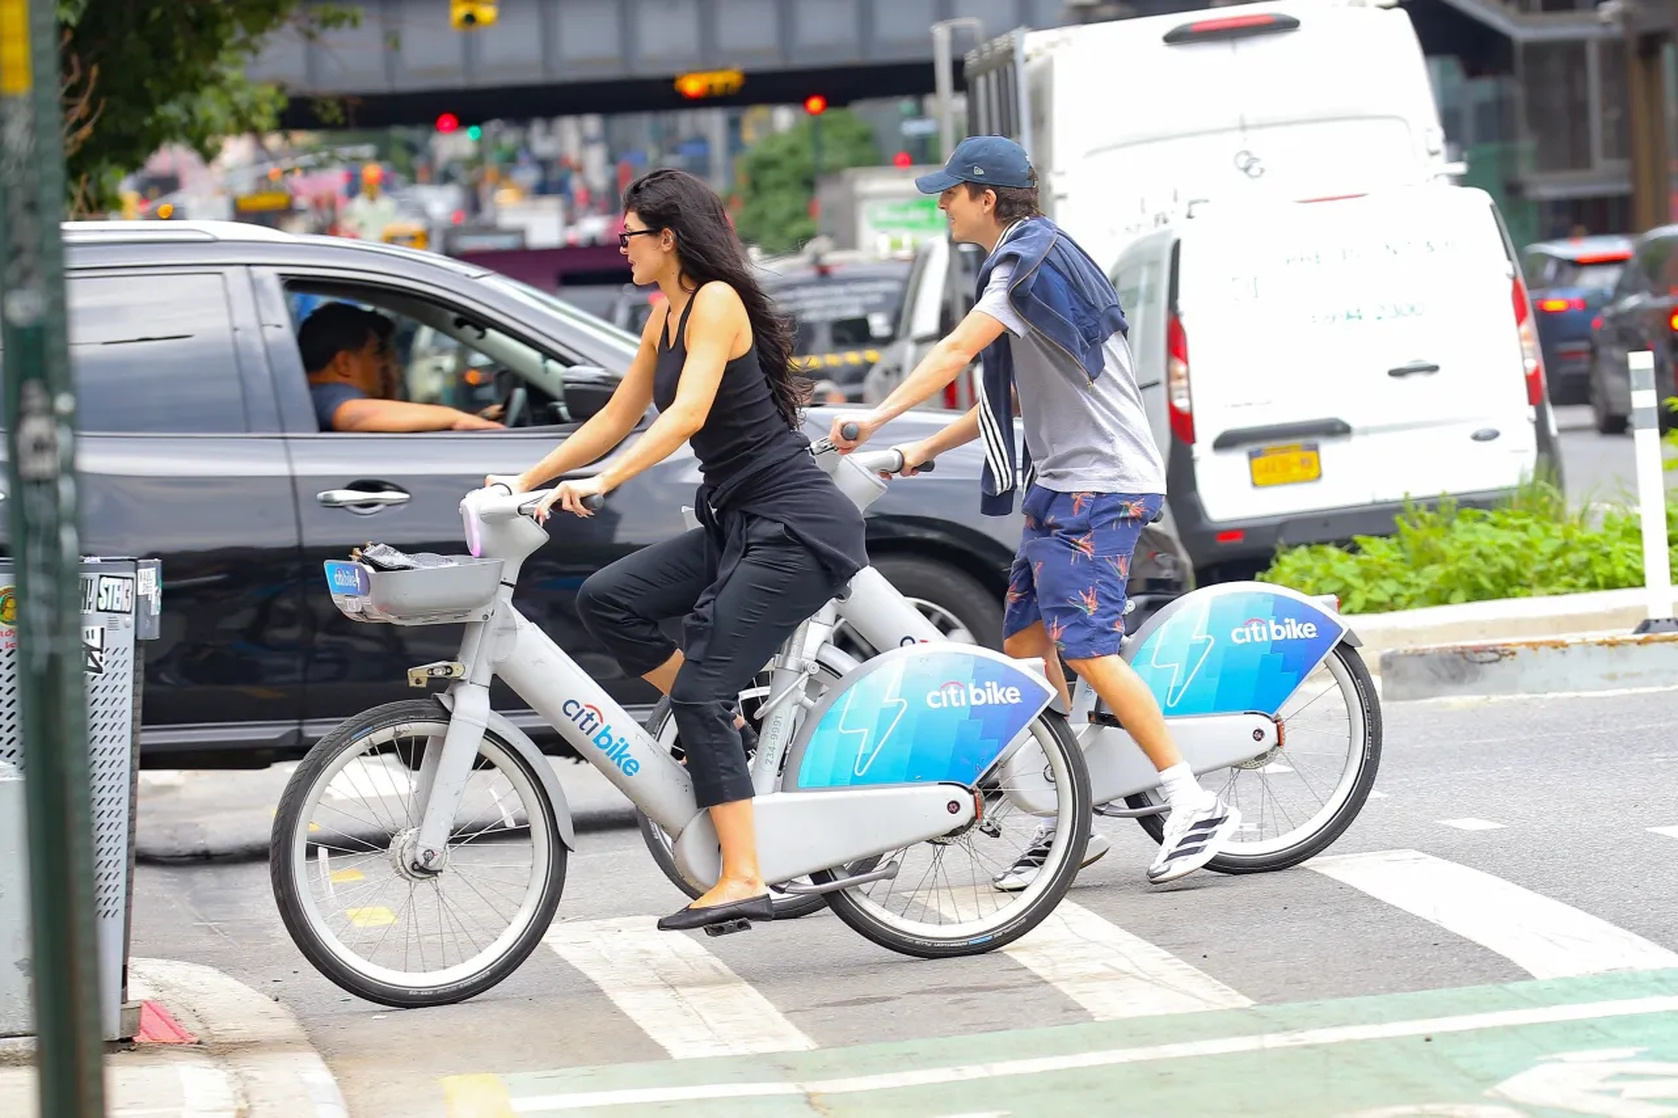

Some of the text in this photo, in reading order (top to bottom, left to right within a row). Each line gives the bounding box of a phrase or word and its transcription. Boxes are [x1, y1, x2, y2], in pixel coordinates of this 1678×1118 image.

[1230, 617, 1317, 644] citi bike
[926, 681, 1021, 708] citi bike
[562, 699, 640, 777] citi bike
